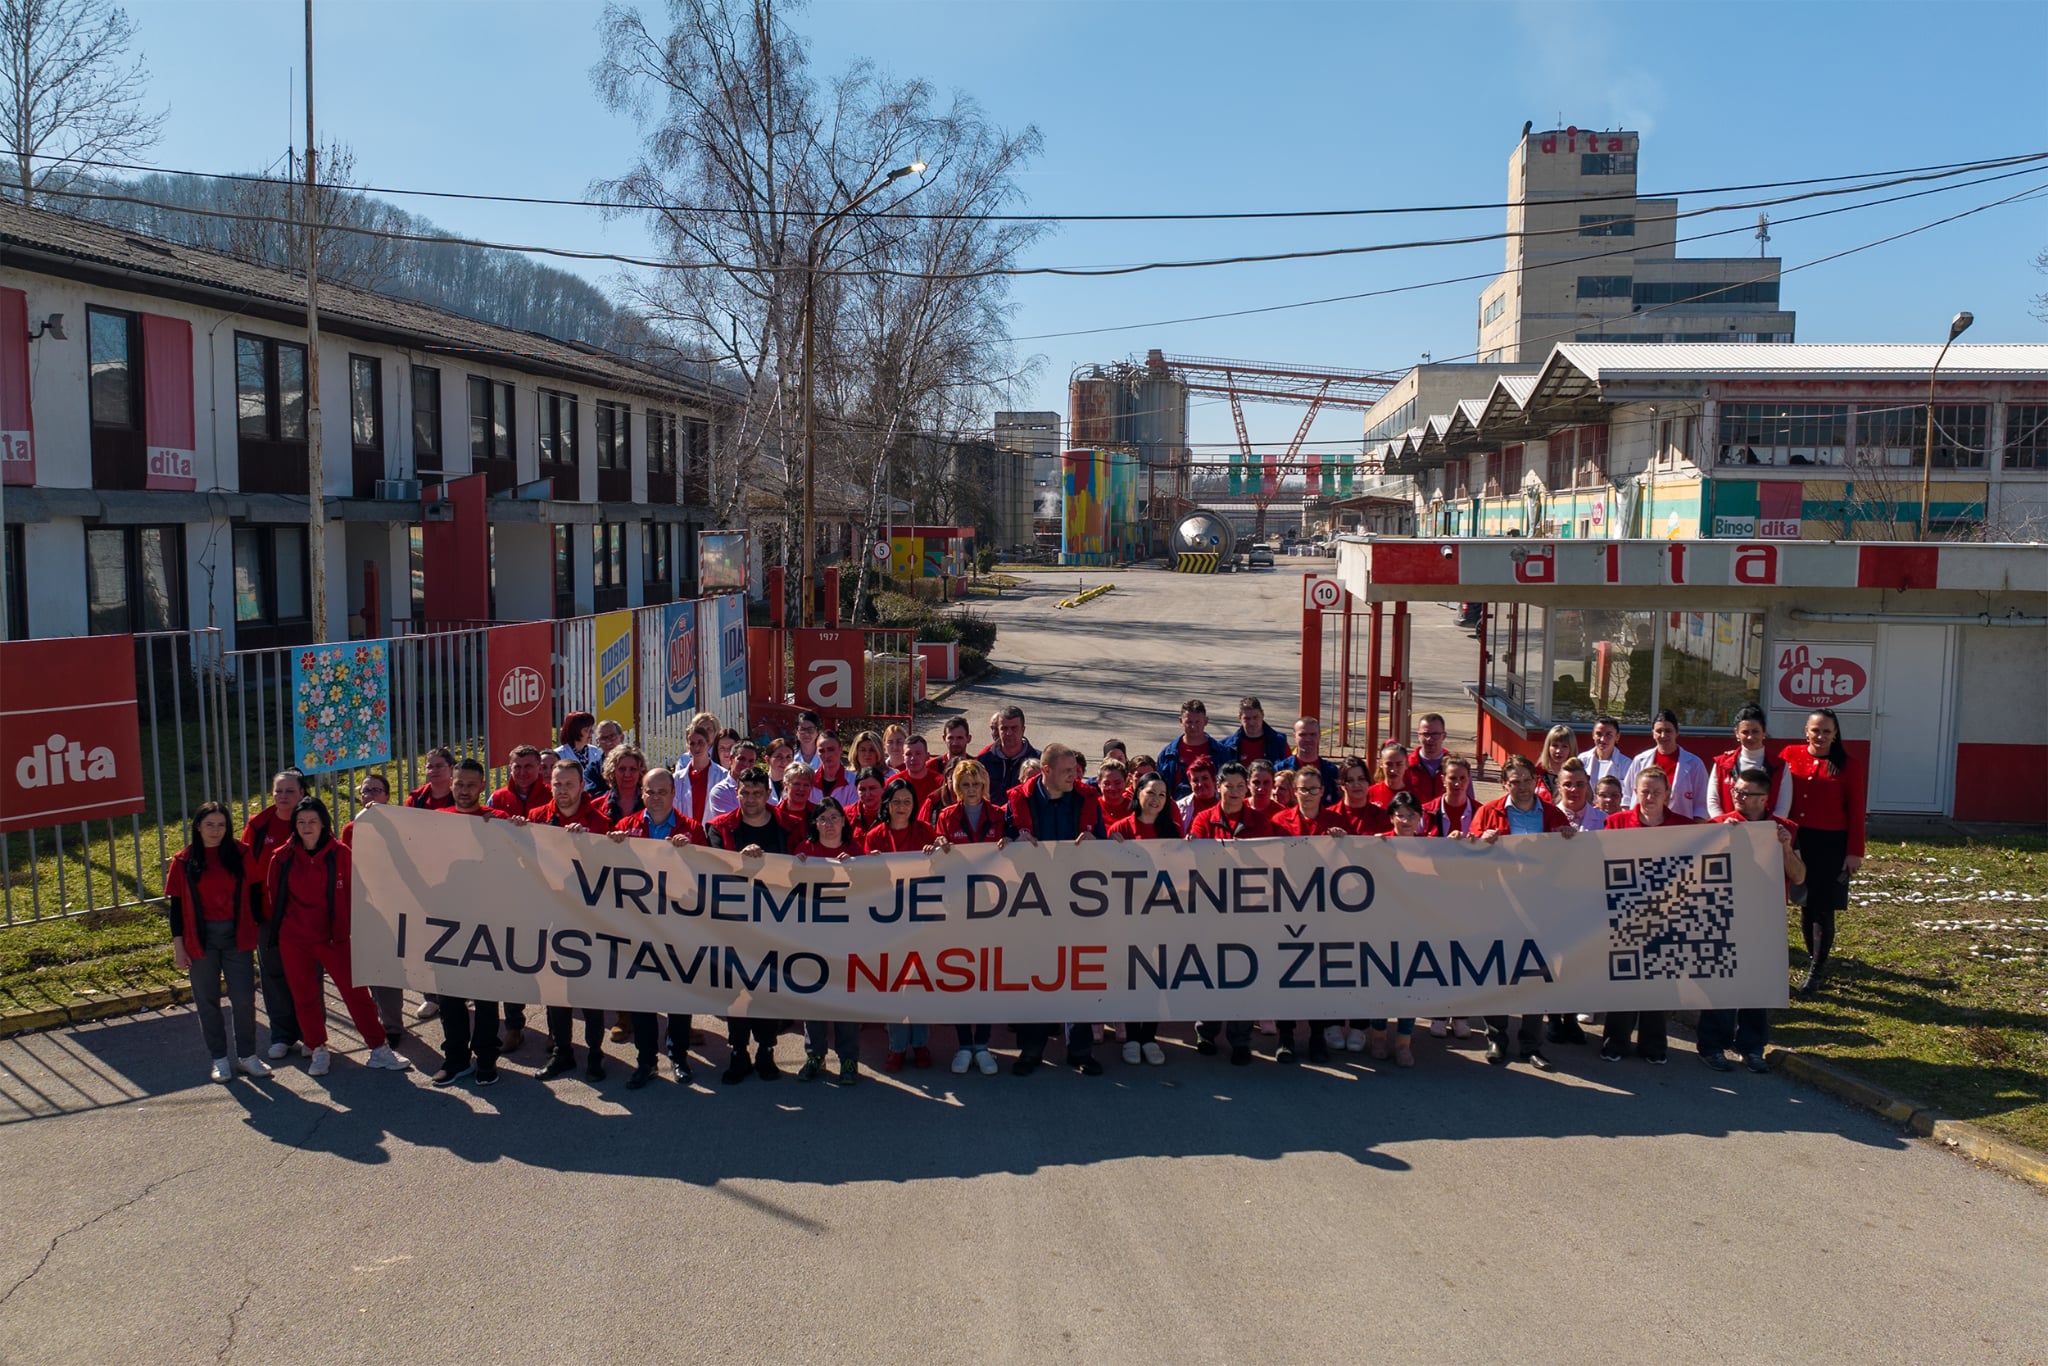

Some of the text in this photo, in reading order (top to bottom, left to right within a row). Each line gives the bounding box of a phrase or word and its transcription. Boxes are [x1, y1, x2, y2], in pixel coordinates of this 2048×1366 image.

[1542, 126, 1624, 154] dita
[151, 450, 192, 476] dita
[1715, 518, 1754, 536] Bingo
[1761, 520, 1799, 537] dita
[879, 546, 885, 556] 5
[1318, 588, 1333, 599] 10
[819, 633, 840, 641] 1977
[600, 631, 631, 679] DOBRO
[669, 630, 694, 686] ARIX
[503, 667, 540, 707] dita
[807, 659, 853, 708] a
[1790, 667, 1854, 696] dita
[15, 734, 117, 790] dita
[571, 859, 1376, 924] VRIJEME JE DA STANEMO
[396, 912, 1555, 995] I ZAUSTAVIMO NASILJE NAD ŽENAMA
